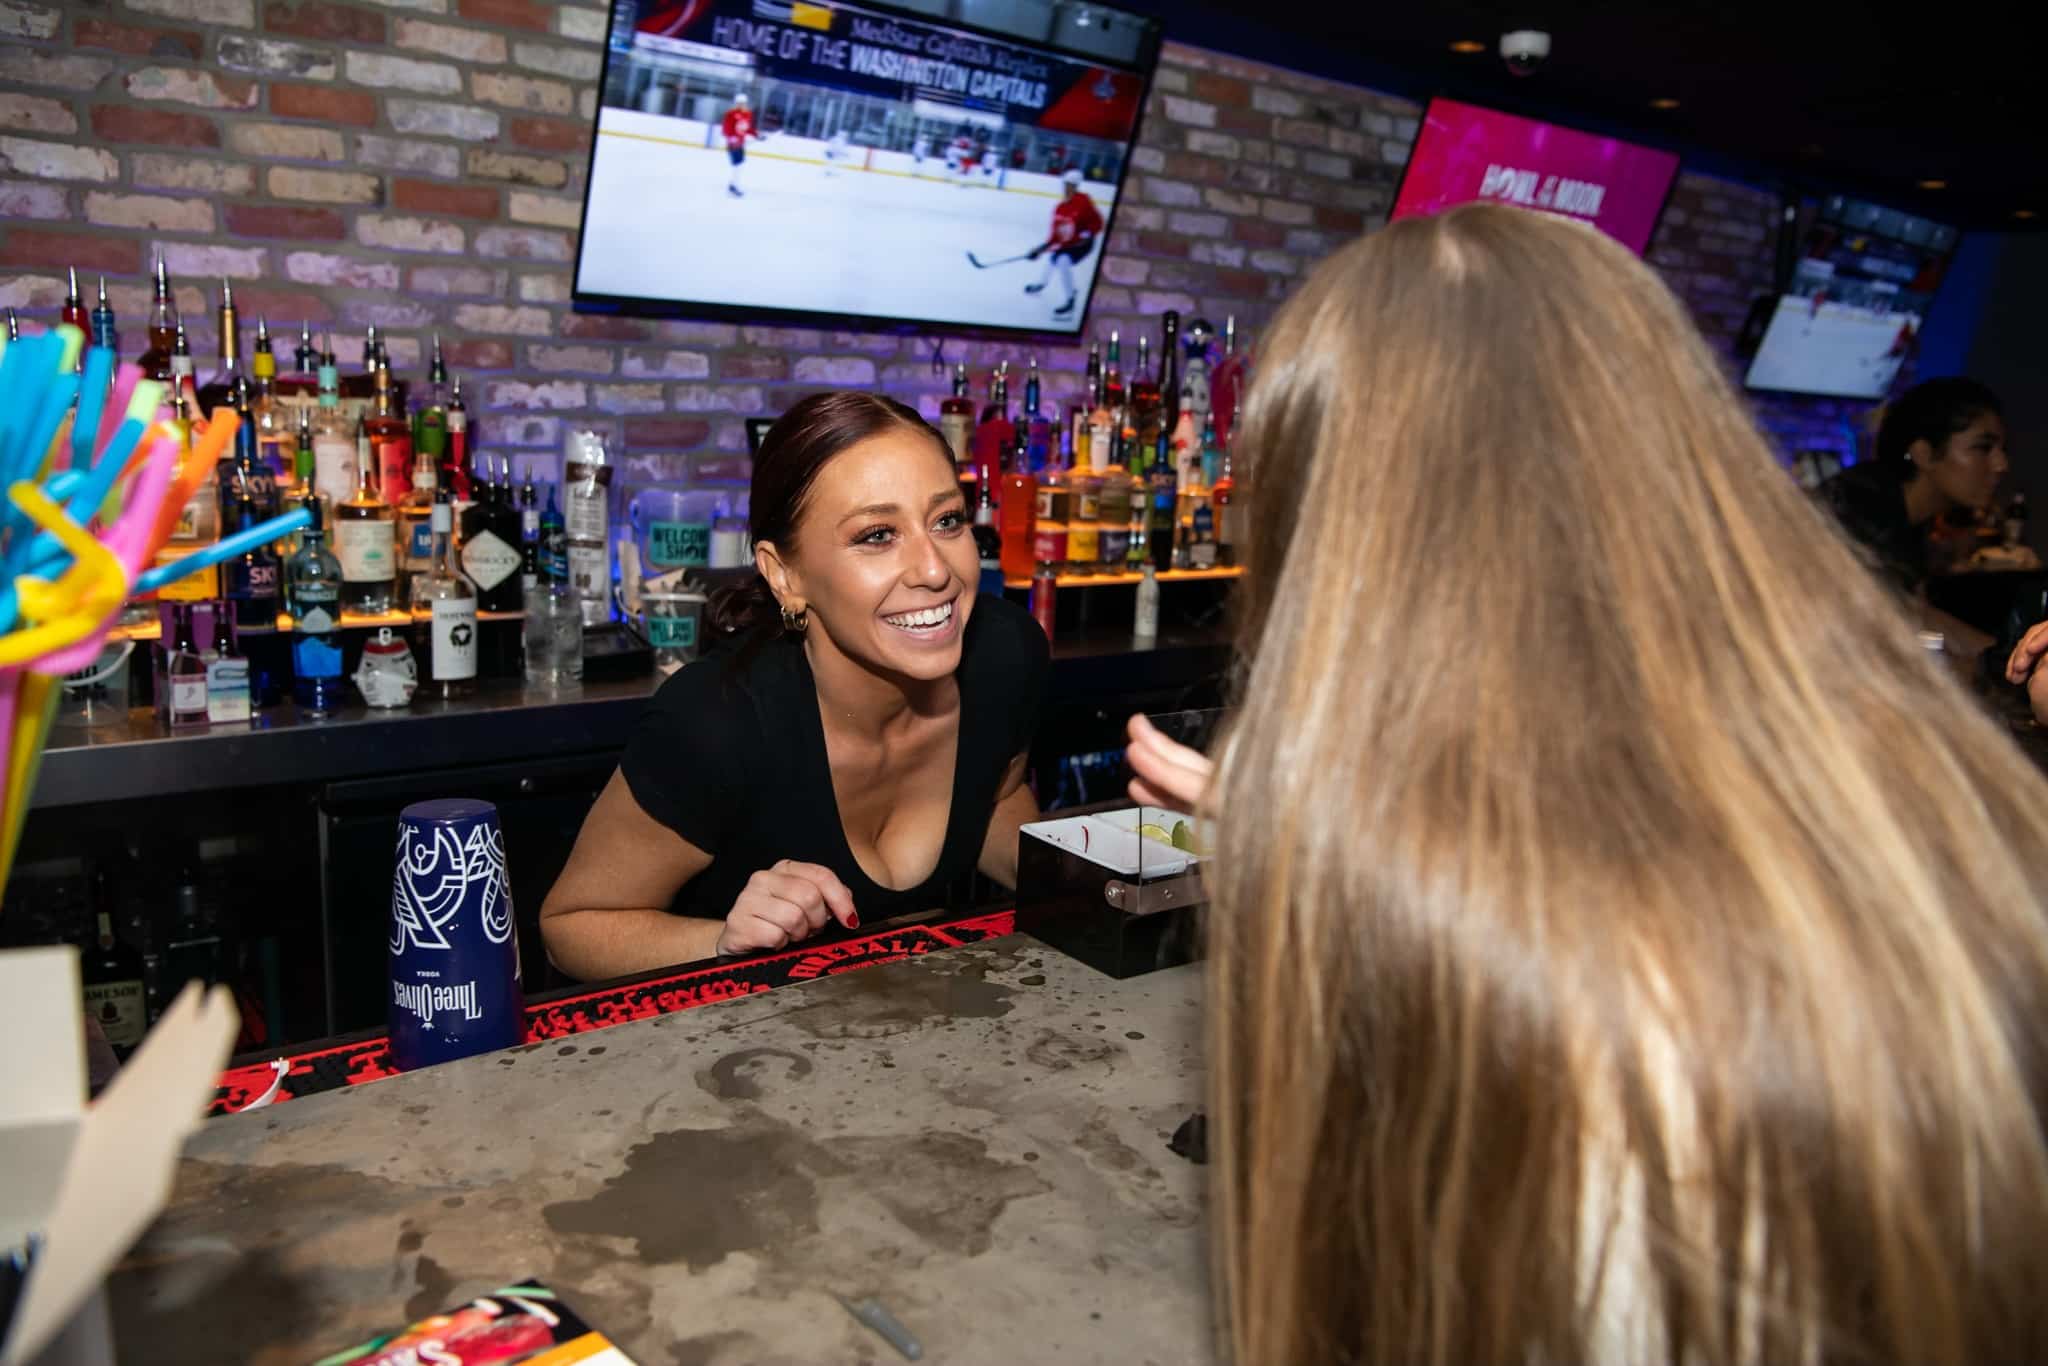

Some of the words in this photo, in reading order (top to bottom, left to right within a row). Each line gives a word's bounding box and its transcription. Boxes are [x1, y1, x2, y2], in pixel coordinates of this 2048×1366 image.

[712, 15, 777, 57] HOME
[778, 28, 806, 61] OF
[810, 34, 849, 70] THE
[850, 44, 970, 92] WASHINGTON
[969, 69, 1048, 109] CAPITALS
[787, 940, 929, 978] FIREBALL
[84, 985, 138, 1000] AMESON
